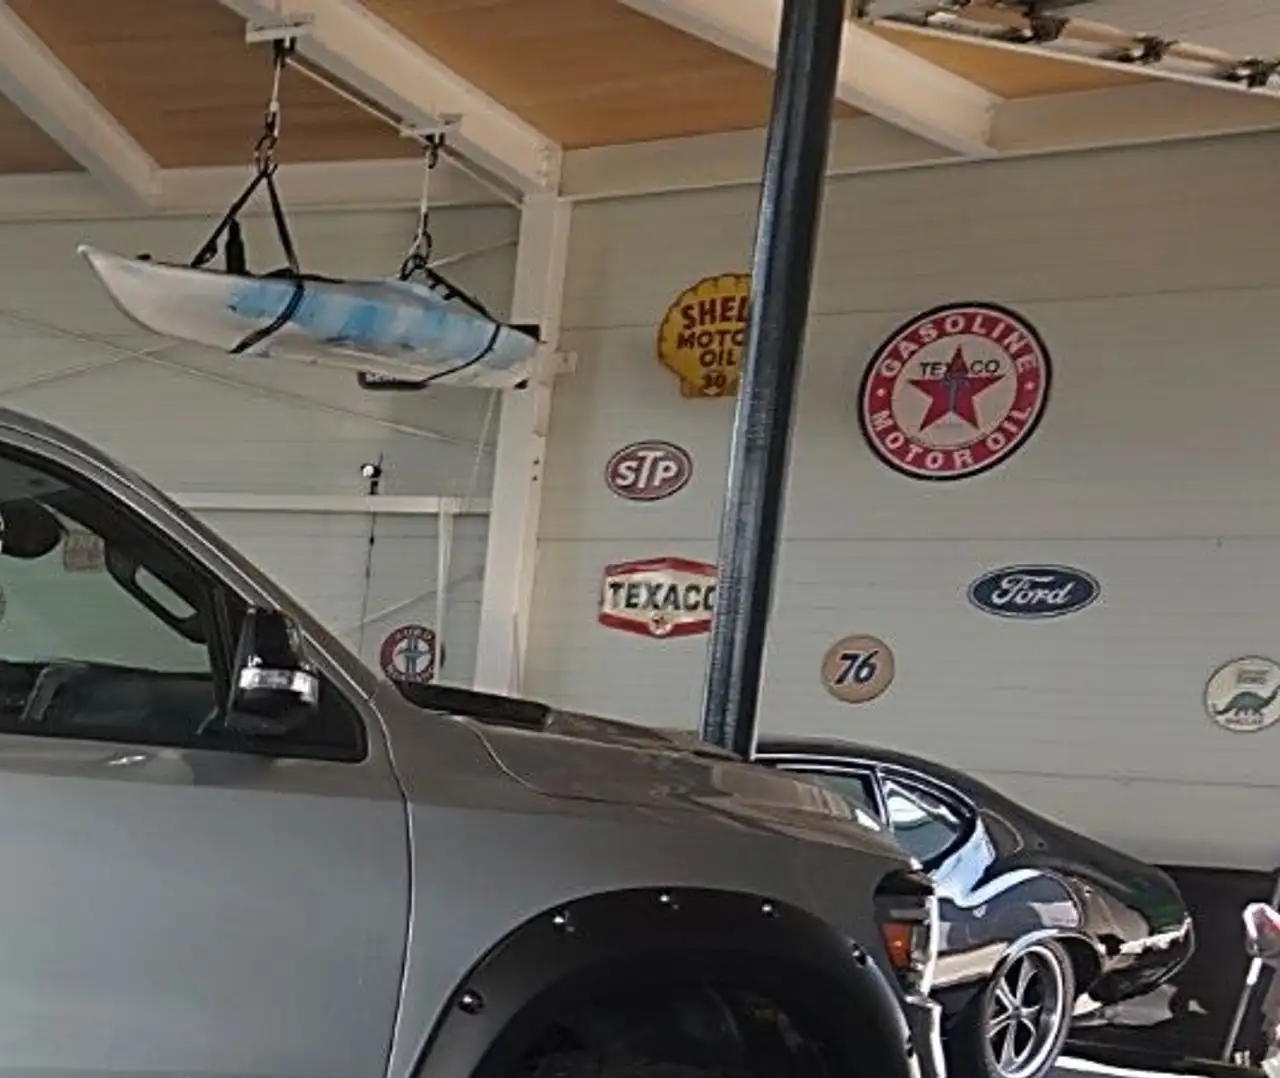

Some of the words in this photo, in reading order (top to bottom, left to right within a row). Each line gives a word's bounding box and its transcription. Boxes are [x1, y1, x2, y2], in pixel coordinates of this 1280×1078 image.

[681, 296, 749, 329] SHEL
[676, 329, 744, 349] MOTO
[880, 314, 1038, 378] GASOLINE
[699, 348, 737, 368] OIL
[920, 359, 1000, 377] TEXCO
[870, 410, 974, 470] MOTOR
[985, 407, 1033, 450] OIL
[614, 450, 680, 490] STP
[991, 574, 1076, 606] Ford
[834, 650, 880, 686] 76
